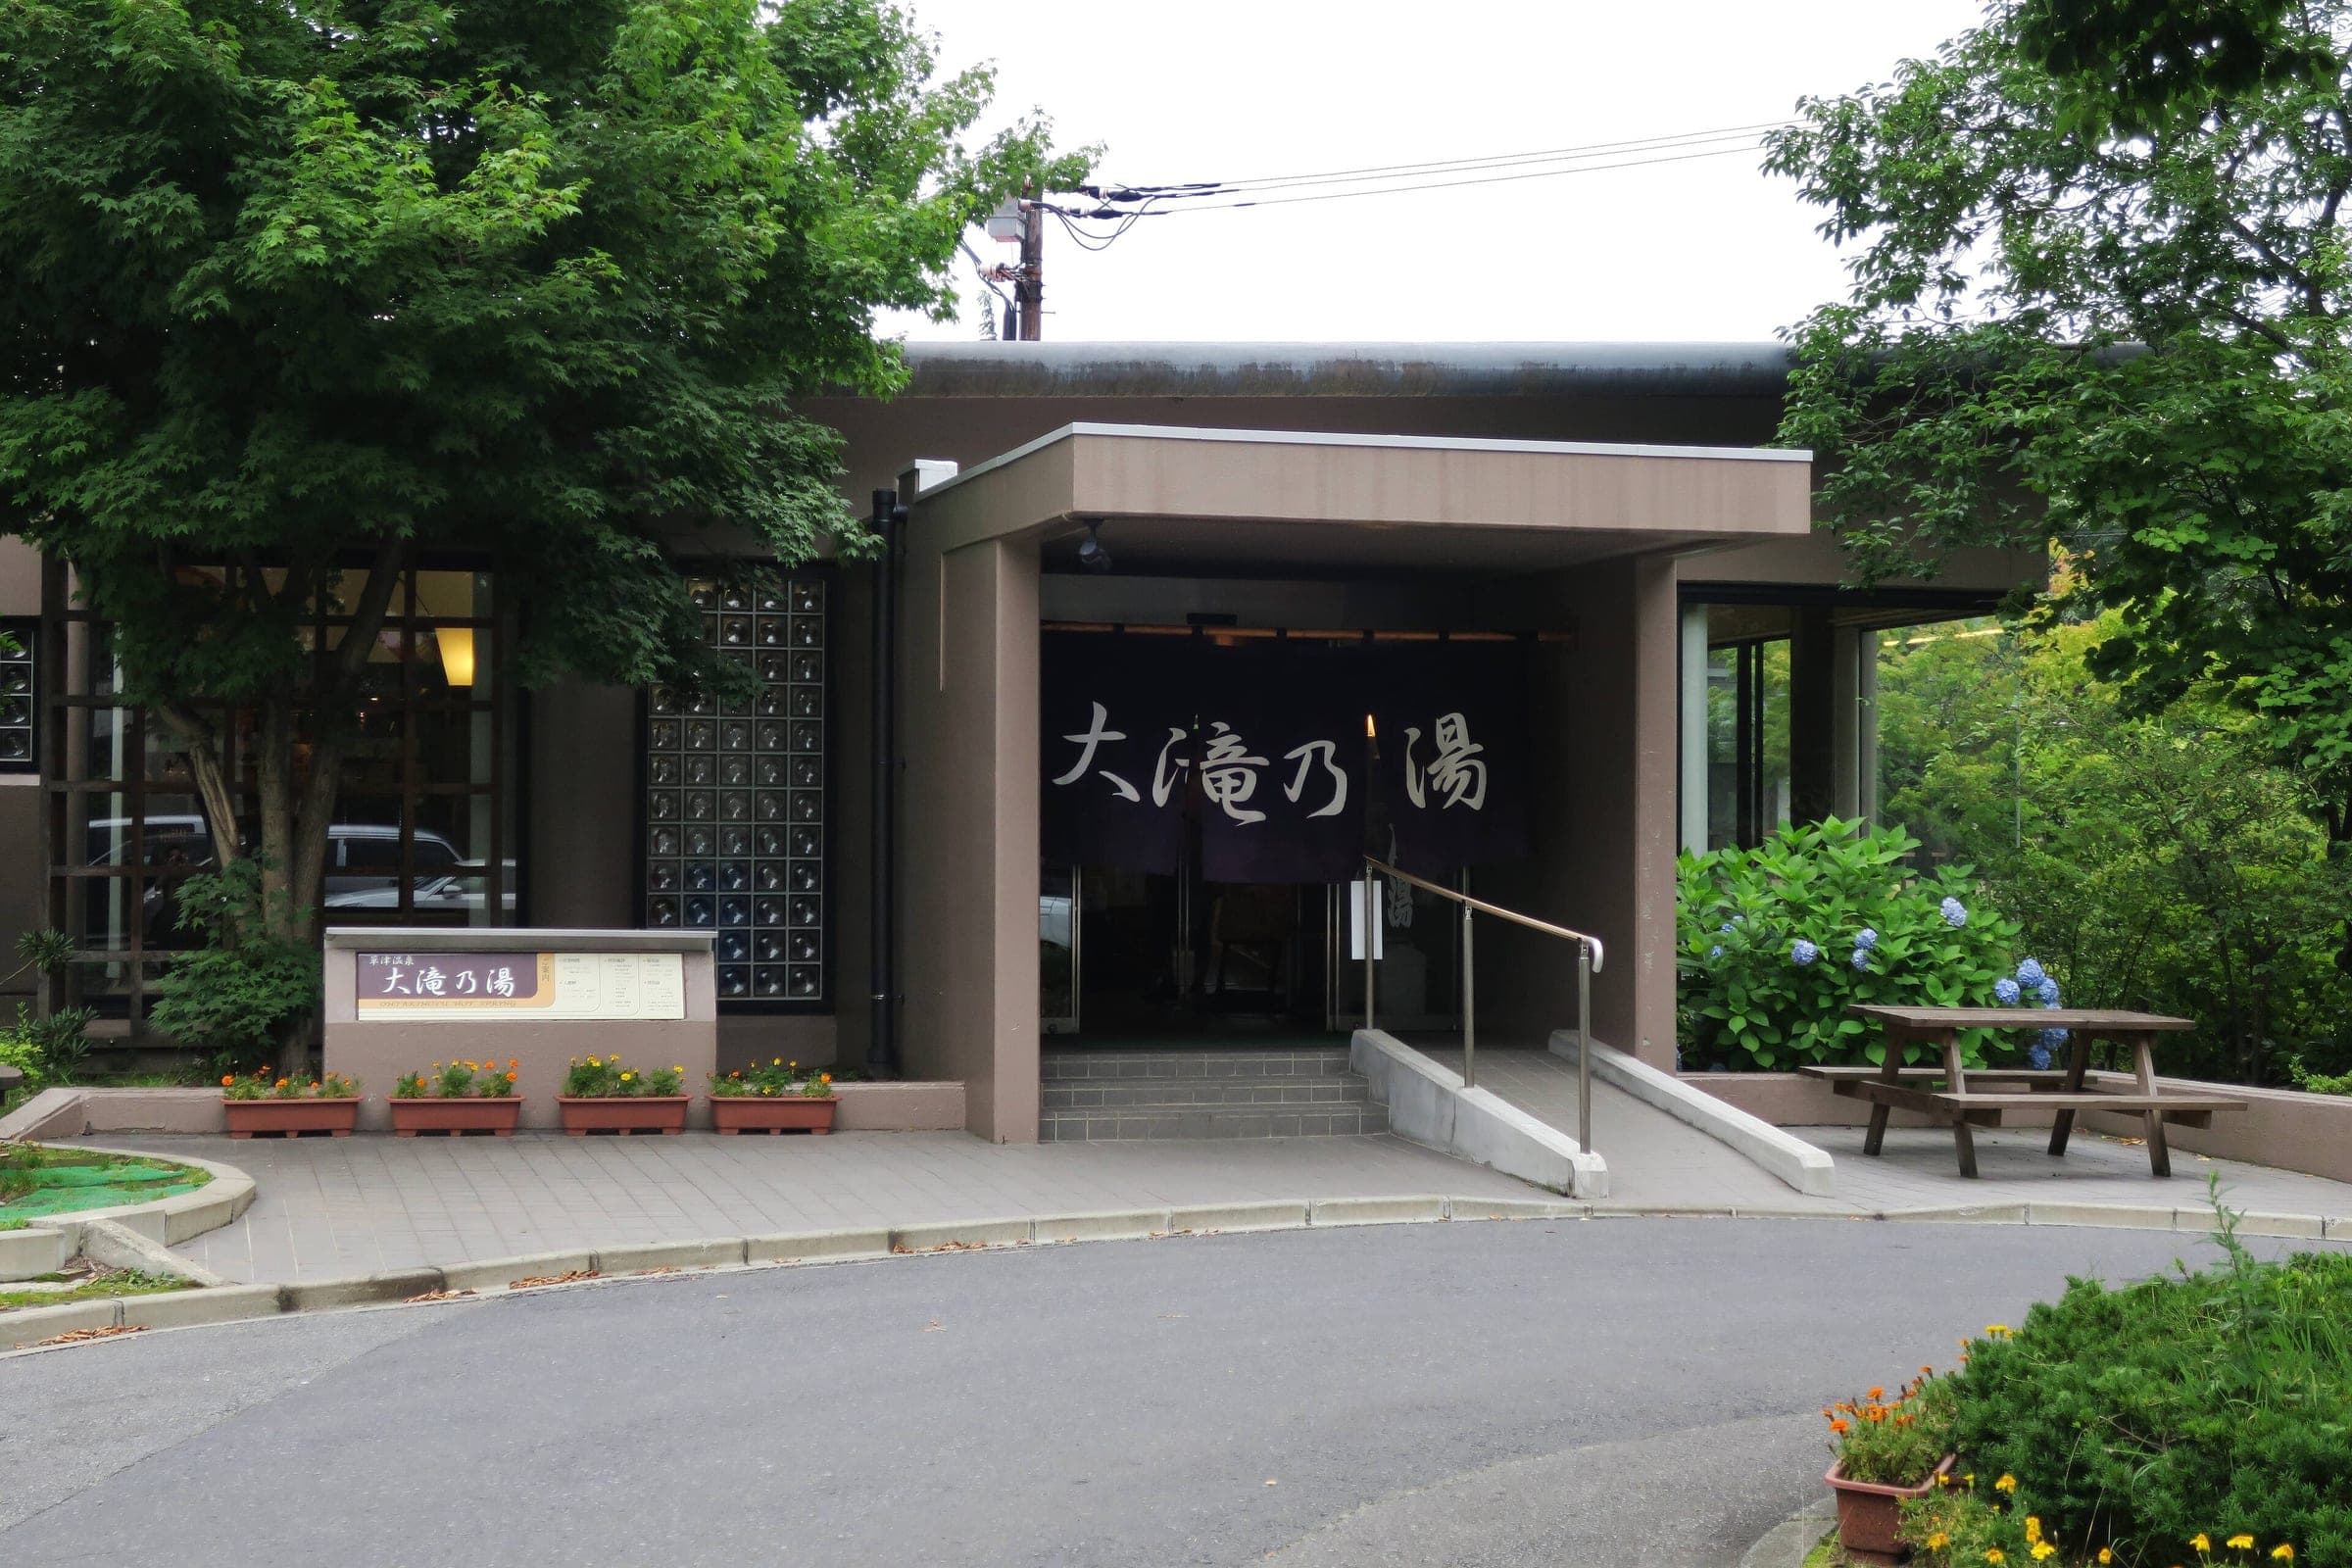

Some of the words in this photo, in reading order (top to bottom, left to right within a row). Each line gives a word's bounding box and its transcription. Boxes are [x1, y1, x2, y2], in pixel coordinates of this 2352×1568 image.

[1052, 701, 1488, 826] 大滝乃湯
[382, 966, 515, 998] 大滝乃湯
